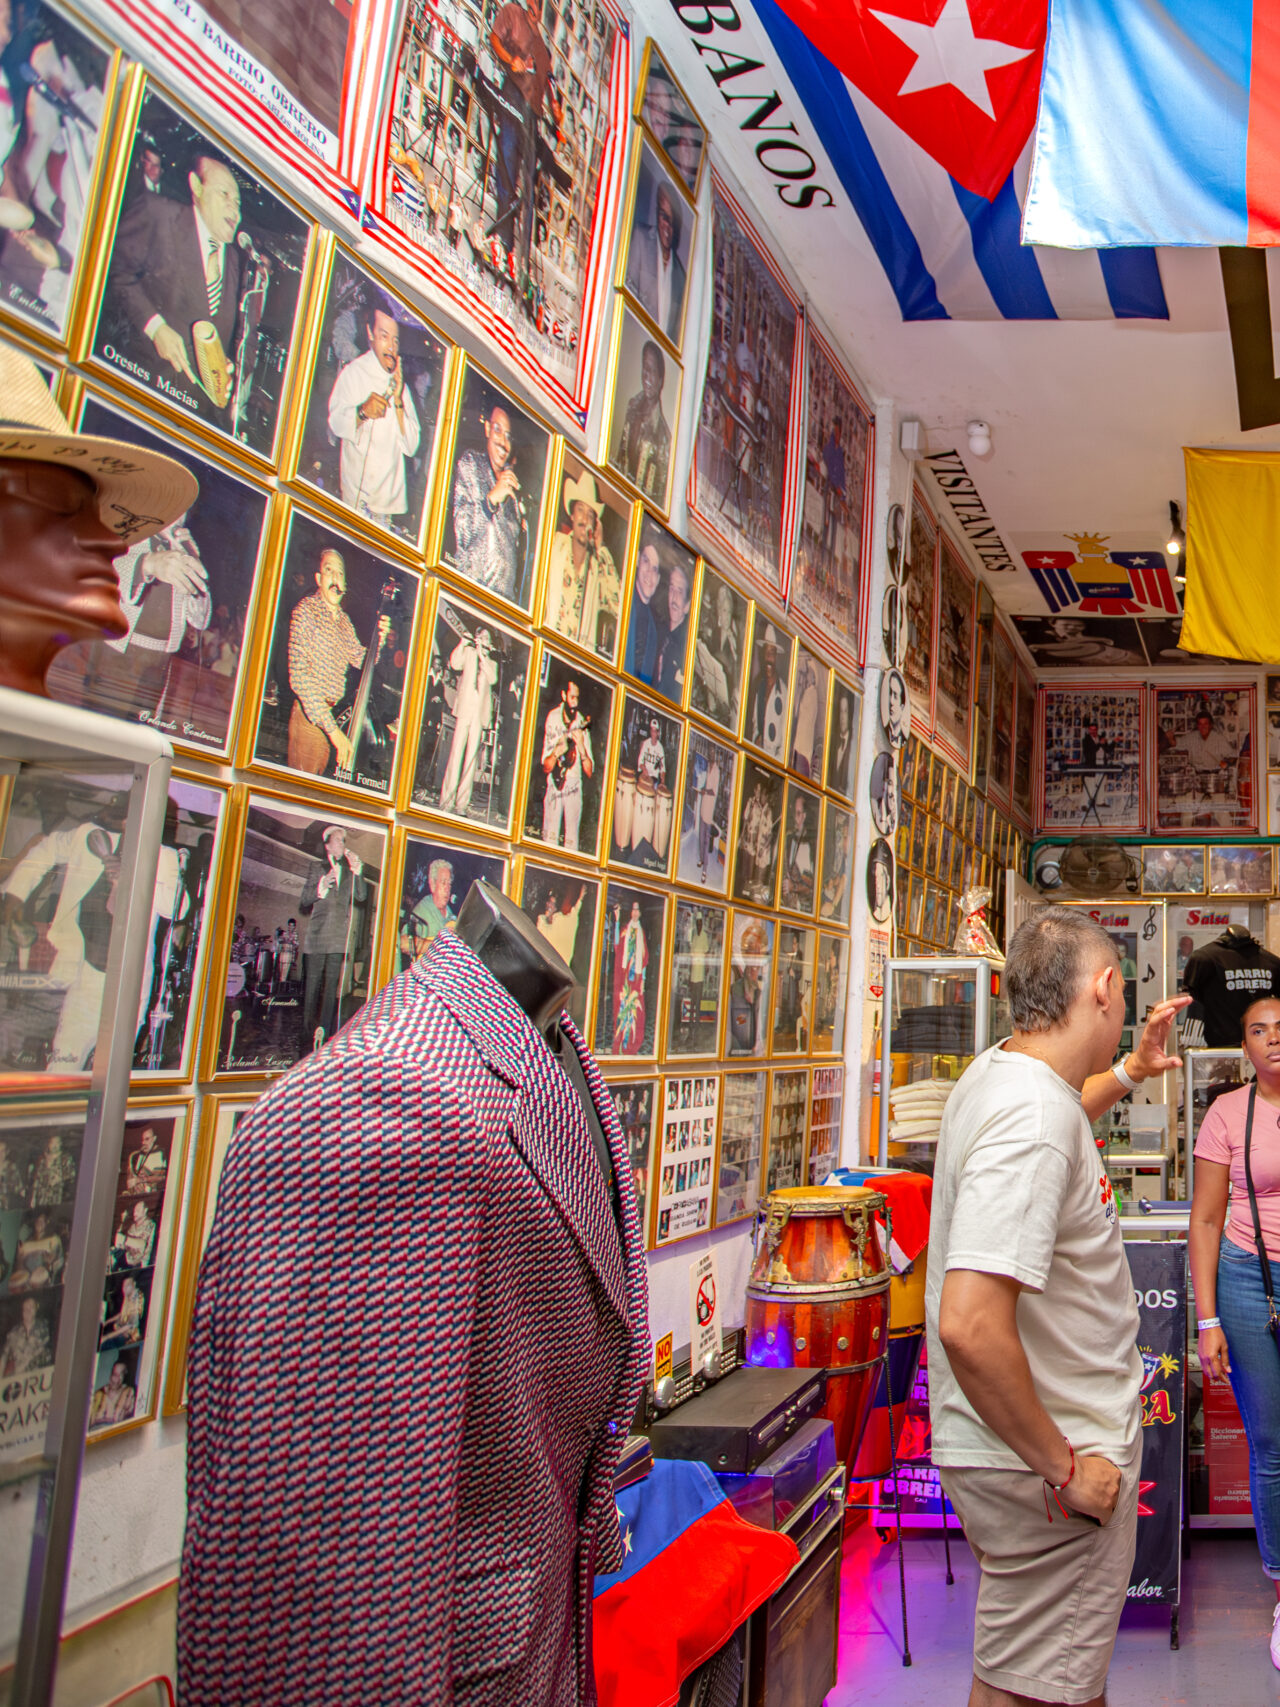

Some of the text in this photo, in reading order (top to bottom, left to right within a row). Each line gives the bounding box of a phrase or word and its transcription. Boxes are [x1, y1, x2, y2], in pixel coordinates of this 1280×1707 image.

[424, 8, 462, 50] SALSA
[174, 0, 327, 145] EL BARRIO OBRERO
[260, 93, 293, 129] CARLOS
[293, 127, 326, 161] MOLINA
[103, 344, 199, 410] Orestes Macias
[923, 448, 1018, 572] VISITANTES
[139, 710, 224, 744] Orlando Contreras
[333, 766, 388, 790] Juan Formell
[1089, 910, 1130, 927] Salsa
[1186, 909, 1231, 926] Salsa
[1224, 968, 1272, 980] BARRIO
[1226, 979, 1272, 991] OBRERO
[657, 1341, 670, 1363] NO
[1126, 1577, 1163, 1598] abor
